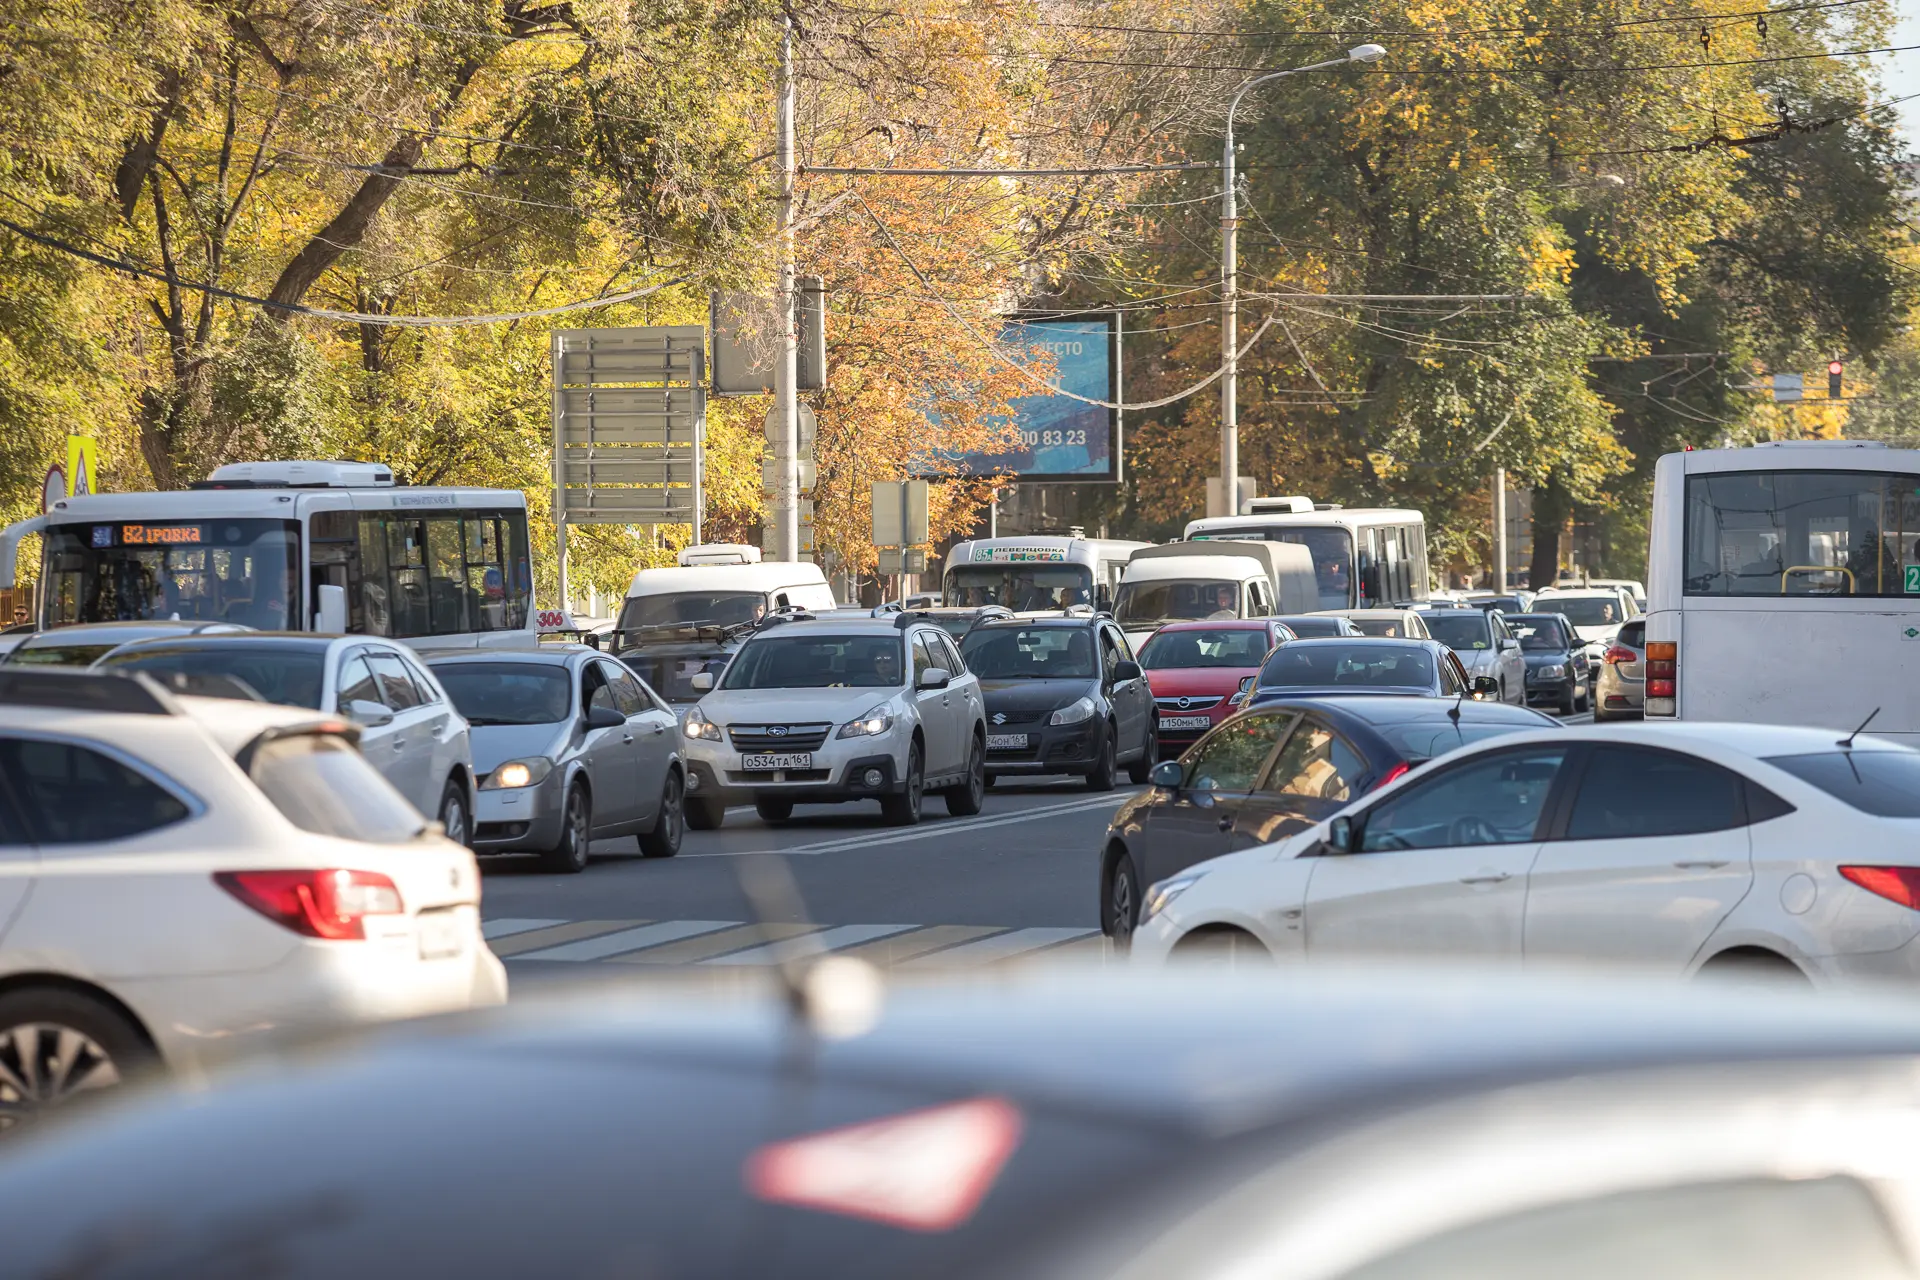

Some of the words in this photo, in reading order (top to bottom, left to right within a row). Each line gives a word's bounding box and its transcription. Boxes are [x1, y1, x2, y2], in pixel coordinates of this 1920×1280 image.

[1042, 430, 1062, 446] 83
[1066, 430, 1086, 446] 23
[123, 525, 144, 543] 82
[1907, 567, 1920, 591] 2
[791, 754, 809, 764] 161
